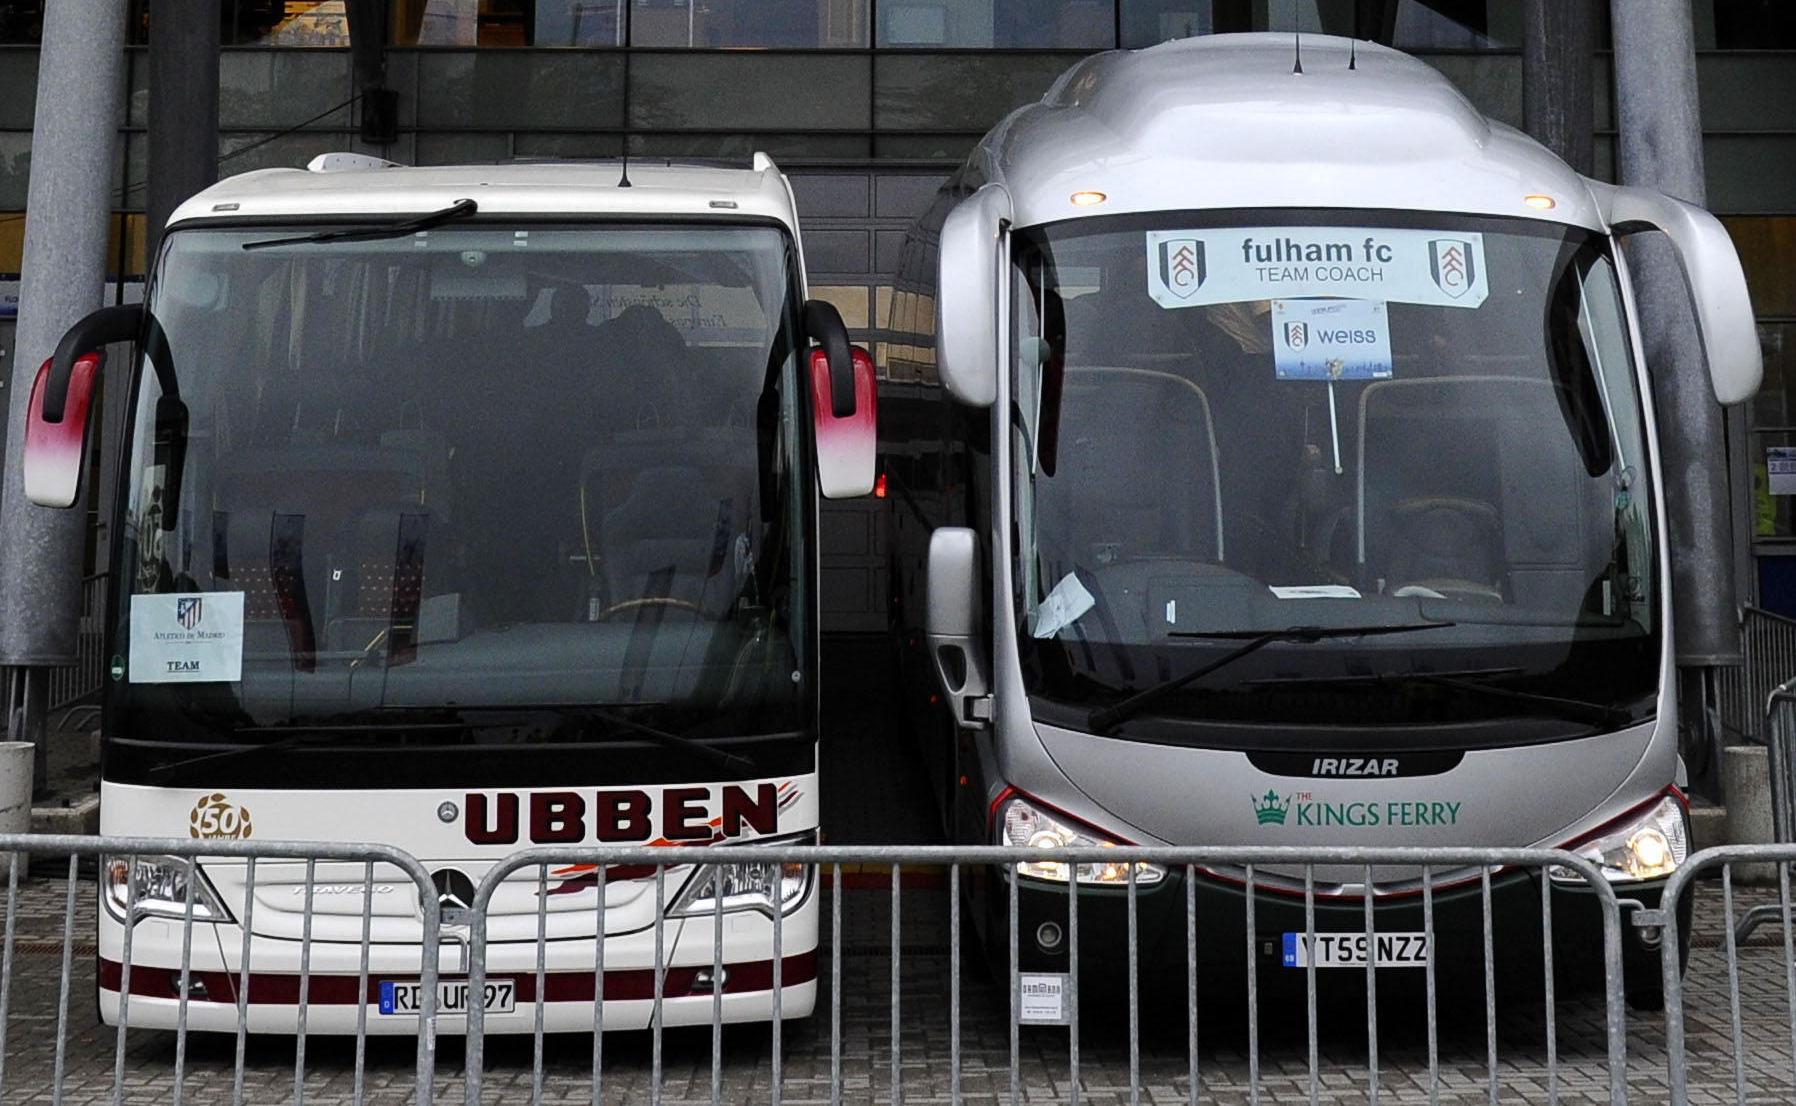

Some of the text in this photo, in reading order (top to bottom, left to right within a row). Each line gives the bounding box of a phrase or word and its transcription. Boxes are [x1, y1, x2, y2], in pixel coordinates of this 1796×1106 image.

[1242, 237, 1393, 263] fulham fc
[1255, 266, 1383, 282] TEAM COACH
[167, 661, 200, 671] TEAM
[1312, 759, 1399, 775] IRIZAR
[1296, 792, 1312, 801] THE
[200, 807, 240, 834] 50
[465, 782, 778, 845] UBBEN
[1297, 802, 1462, 826] KINGS FERRY
[1378, 936, 1427, 962] NZZ
